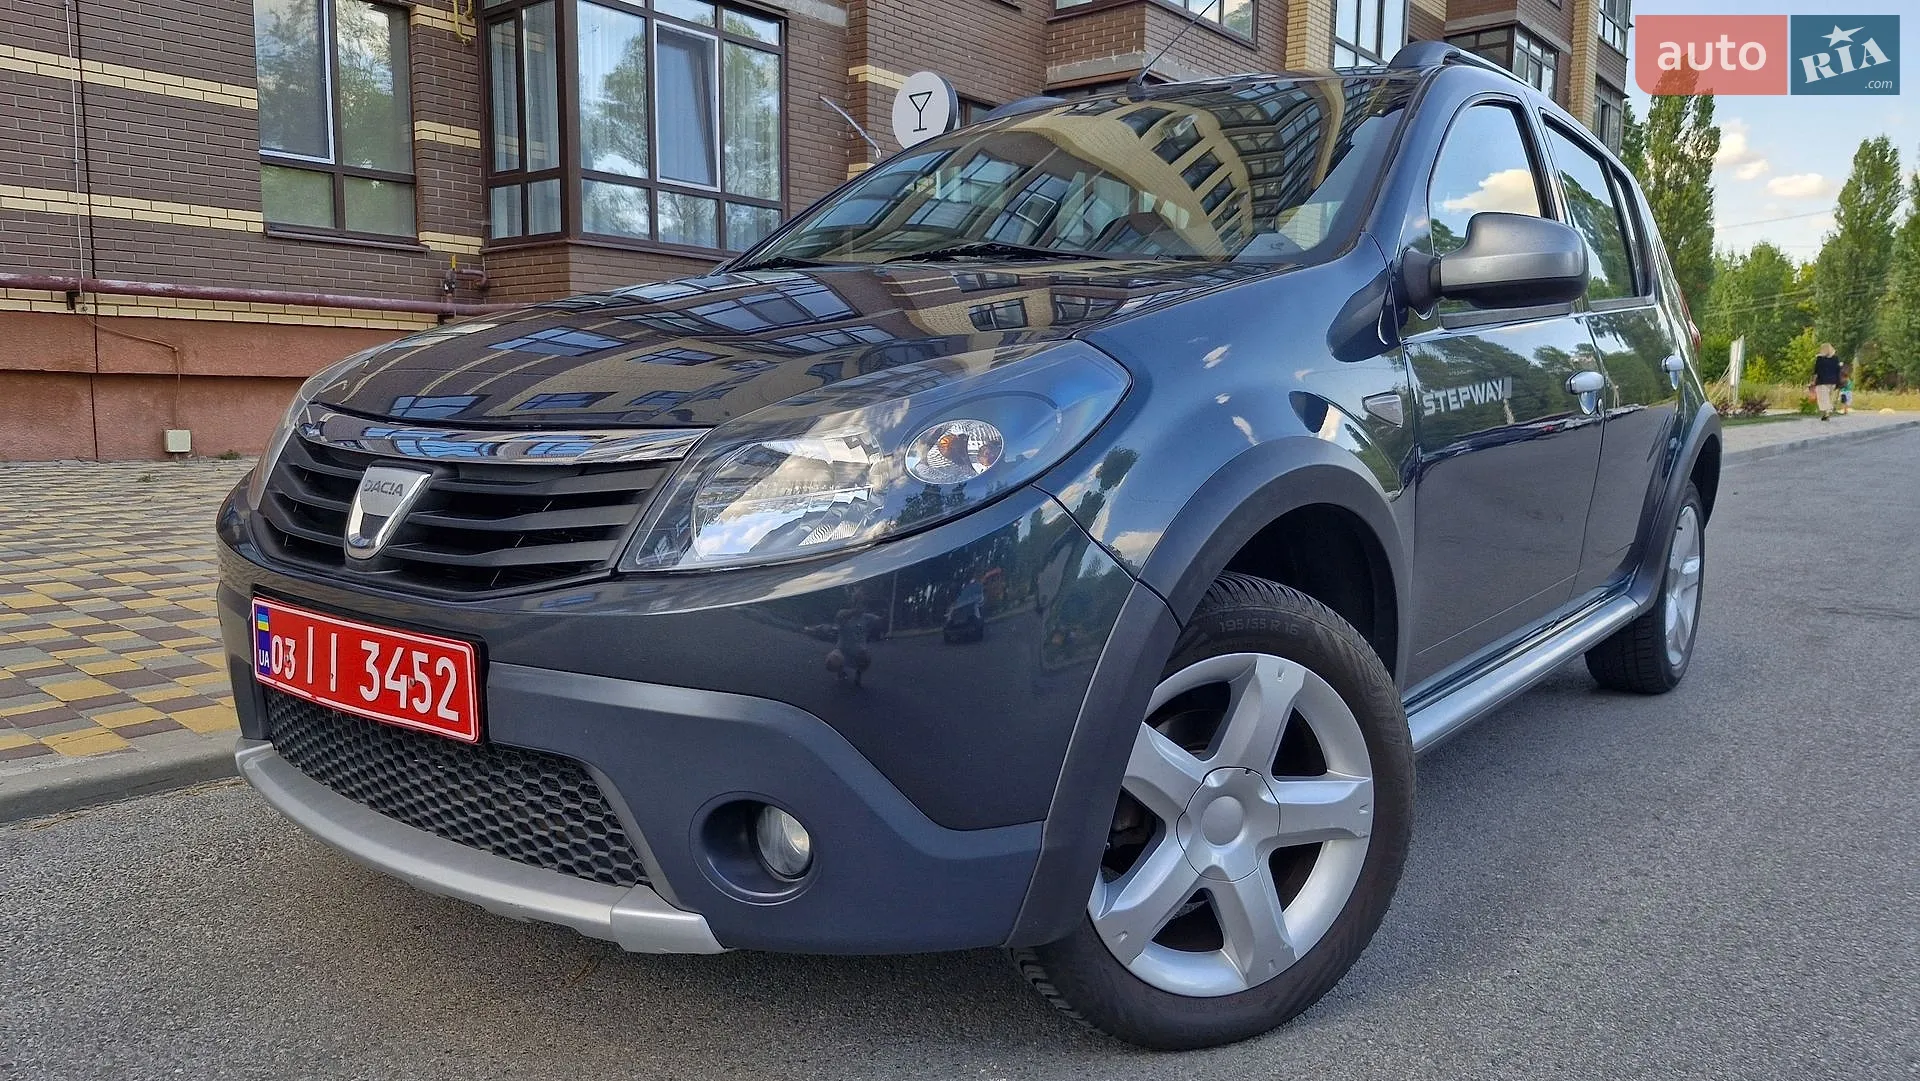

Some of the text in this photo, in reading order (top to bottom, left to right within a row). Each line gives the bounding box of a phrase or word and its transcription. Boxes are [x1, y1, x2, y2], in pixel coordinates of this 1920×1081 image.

[1422, 379, 1503, 416] STEPWAY
[363, 480, 403, 496] DACIA
[258, 648, 270, 668] UA
[271, 634, 296, 680] 03
[359, 639, 460, 722] 3452
